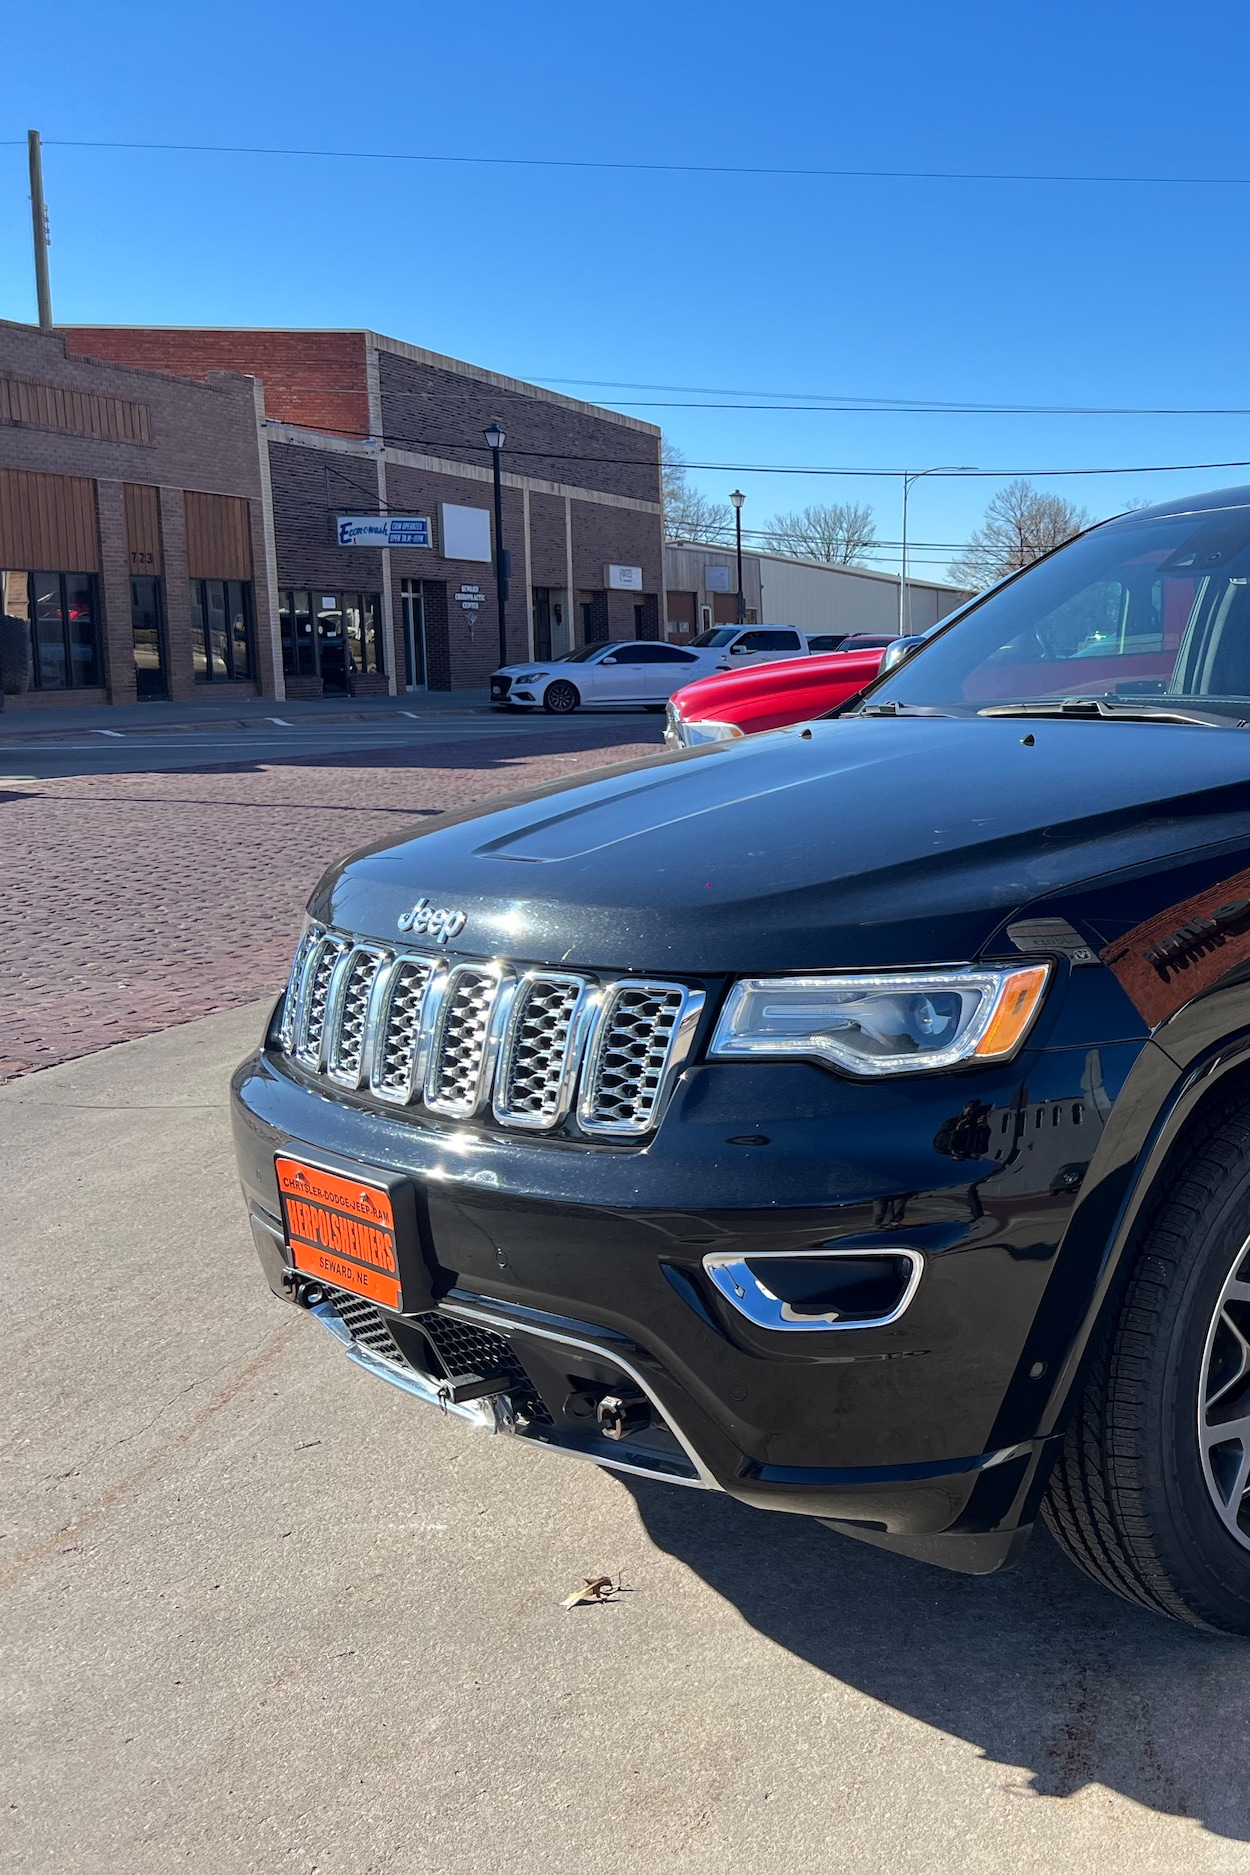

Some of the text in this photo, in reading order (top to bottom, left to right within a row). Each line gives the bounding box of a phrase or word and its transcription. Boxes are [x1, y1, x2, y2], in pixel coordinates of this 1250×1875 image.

[131, 551, 153, 564] 723
[398, 898, 467, 944] Jeep
[286, 1198, 397, 1274] HERPOLSHEIMERS
[319, 1256, 369, 1286] SEWARD, NE
